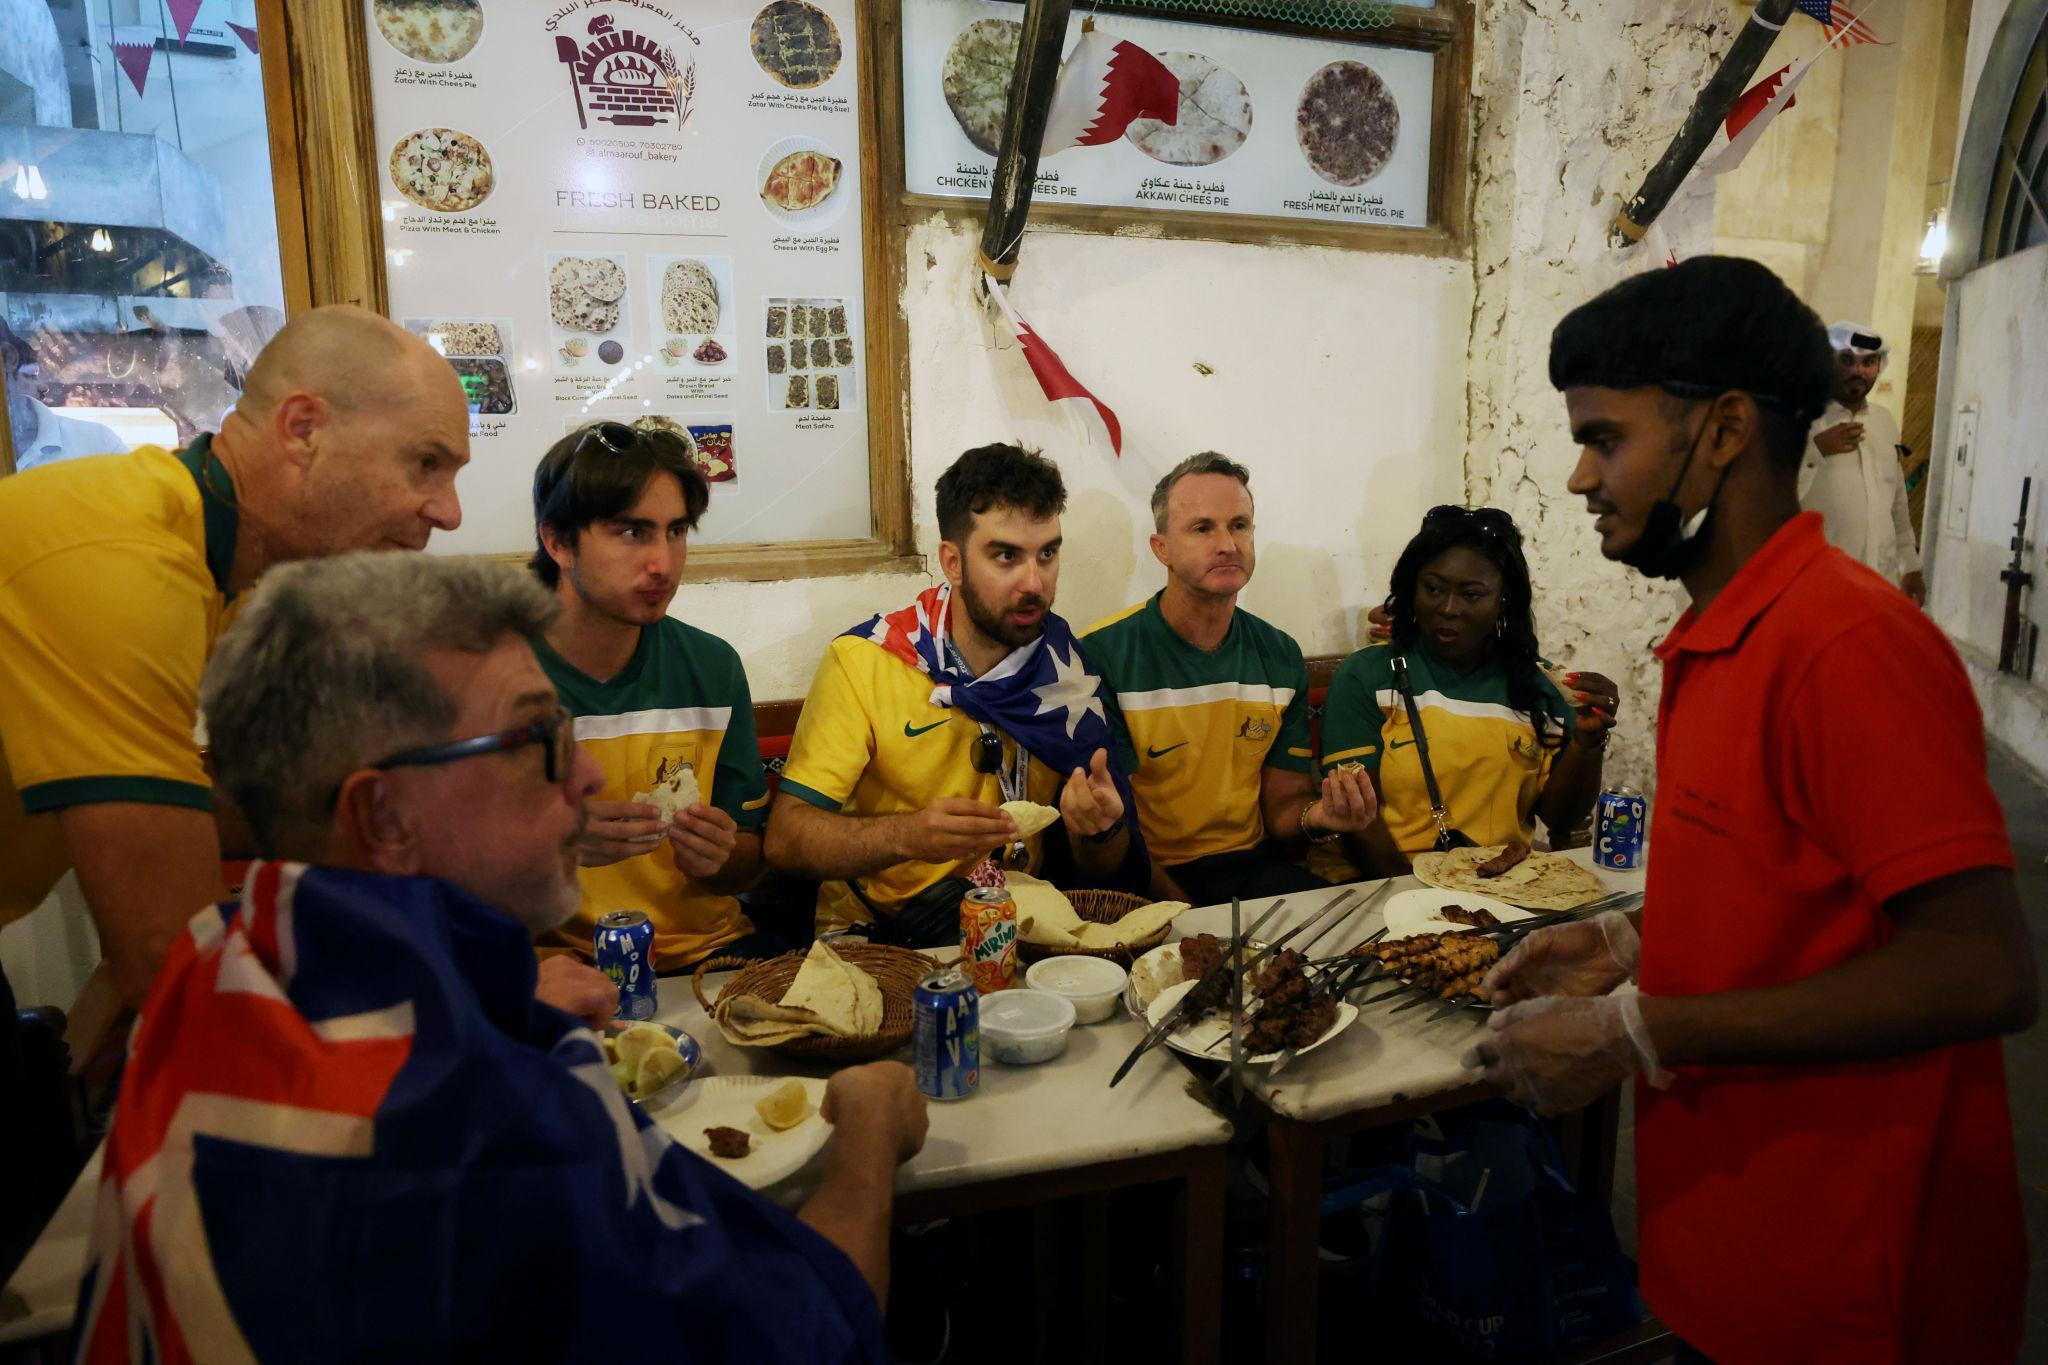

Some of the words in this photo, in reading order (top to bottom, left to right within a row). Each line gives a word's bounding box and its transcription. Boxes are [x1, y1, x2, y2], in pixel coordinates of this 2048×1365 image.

[545, 2, 579, 31] البلدي
[395, 68, 412, 77] زعتر
[415, 70, 425, 78] مع
[428, 70, 446, 79] الجبن
[449, 71, 473, 80] فطيرة
[394, 76, 416, 84] Zatar
[439, 79, 463, 87] Chees
[748, 100, 766, 108] Zatar
[828, 97, 848, 105] فطيرة
[599, 148, 678, 163] almaarouf_bakery
[936, 176, 987, 189] CHICKEN
[1031, 184, 1058, 195] HEES
[1060, 186, 1077, 196] PIE
[1196, 180, 1225, 194] فطيرة
[556, 190, 635, 209] FRESH
[643, 193, 721, 211] BAKED
[1135, 190, 1177, 202] AKKAWI
[1179, 193, 1212, 205] CHEES
[1214, 196, 1229, 206] PIE
[1357, 193, 1384, 206] فطيرة
[1283, 200, 1314, 211] FRESH
[1315, 203, 1341, 213] MEAT
[1342, 205, 1367, 215] WITH
[1368, 208, 1389, 217] VEG.
[1390, 209, 1405, 219] PIE
[816, 245, 828, 254] Egg
